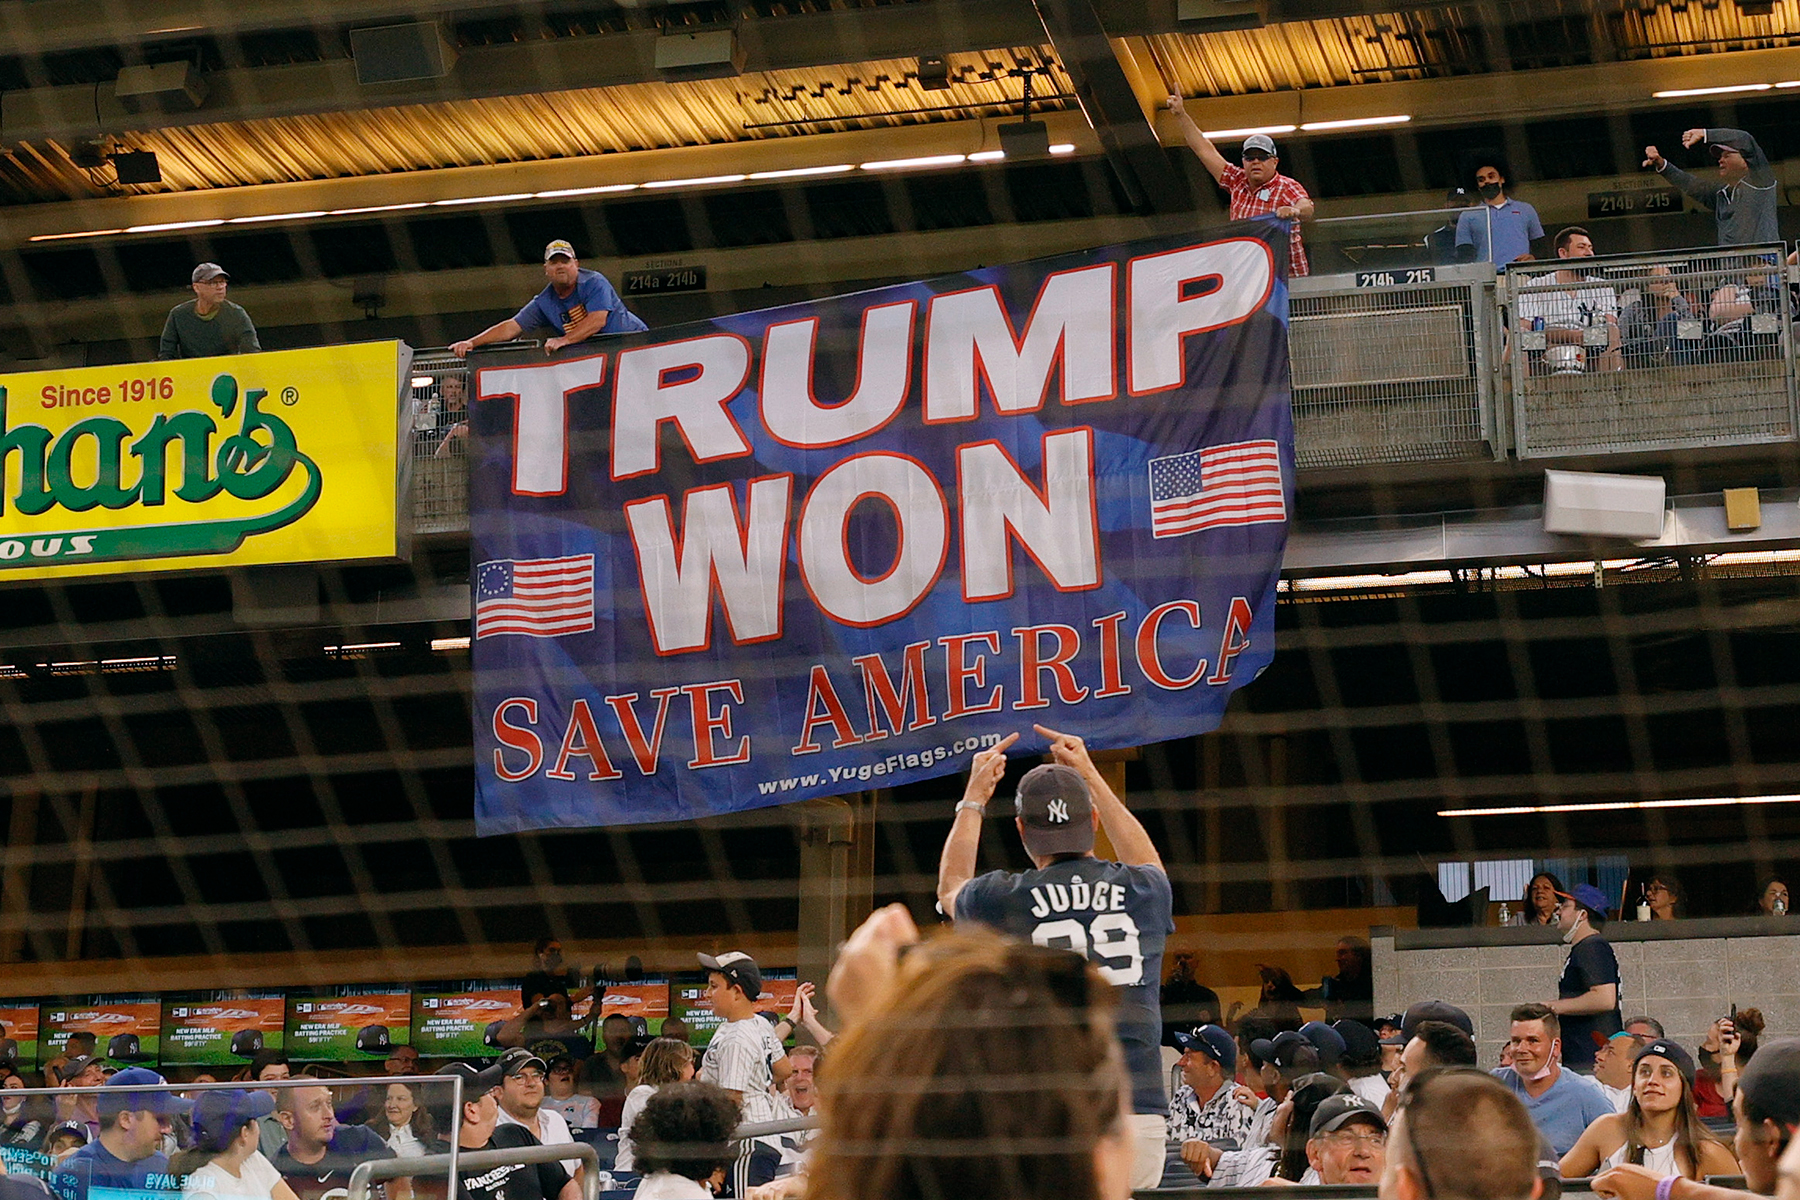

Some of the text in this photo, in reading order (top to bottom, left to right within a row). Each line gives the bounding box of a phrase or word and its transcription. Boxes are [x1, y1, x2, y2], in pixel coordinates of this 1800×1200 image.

[1600, 192, 1670, 212] 214b 215
[629, 270, 697, 290] 214a 214b
[476, 236, 1274, 497] TRUMP
[41, 377, 174, 409] Since 1916
[623, 425, 1103, 656] WON
[492, 679, 750, 782] SAVE
[758, 732, 1001, 795] www.YugeFlags.com
[1030, 880, 1126, 918] JUDGE
